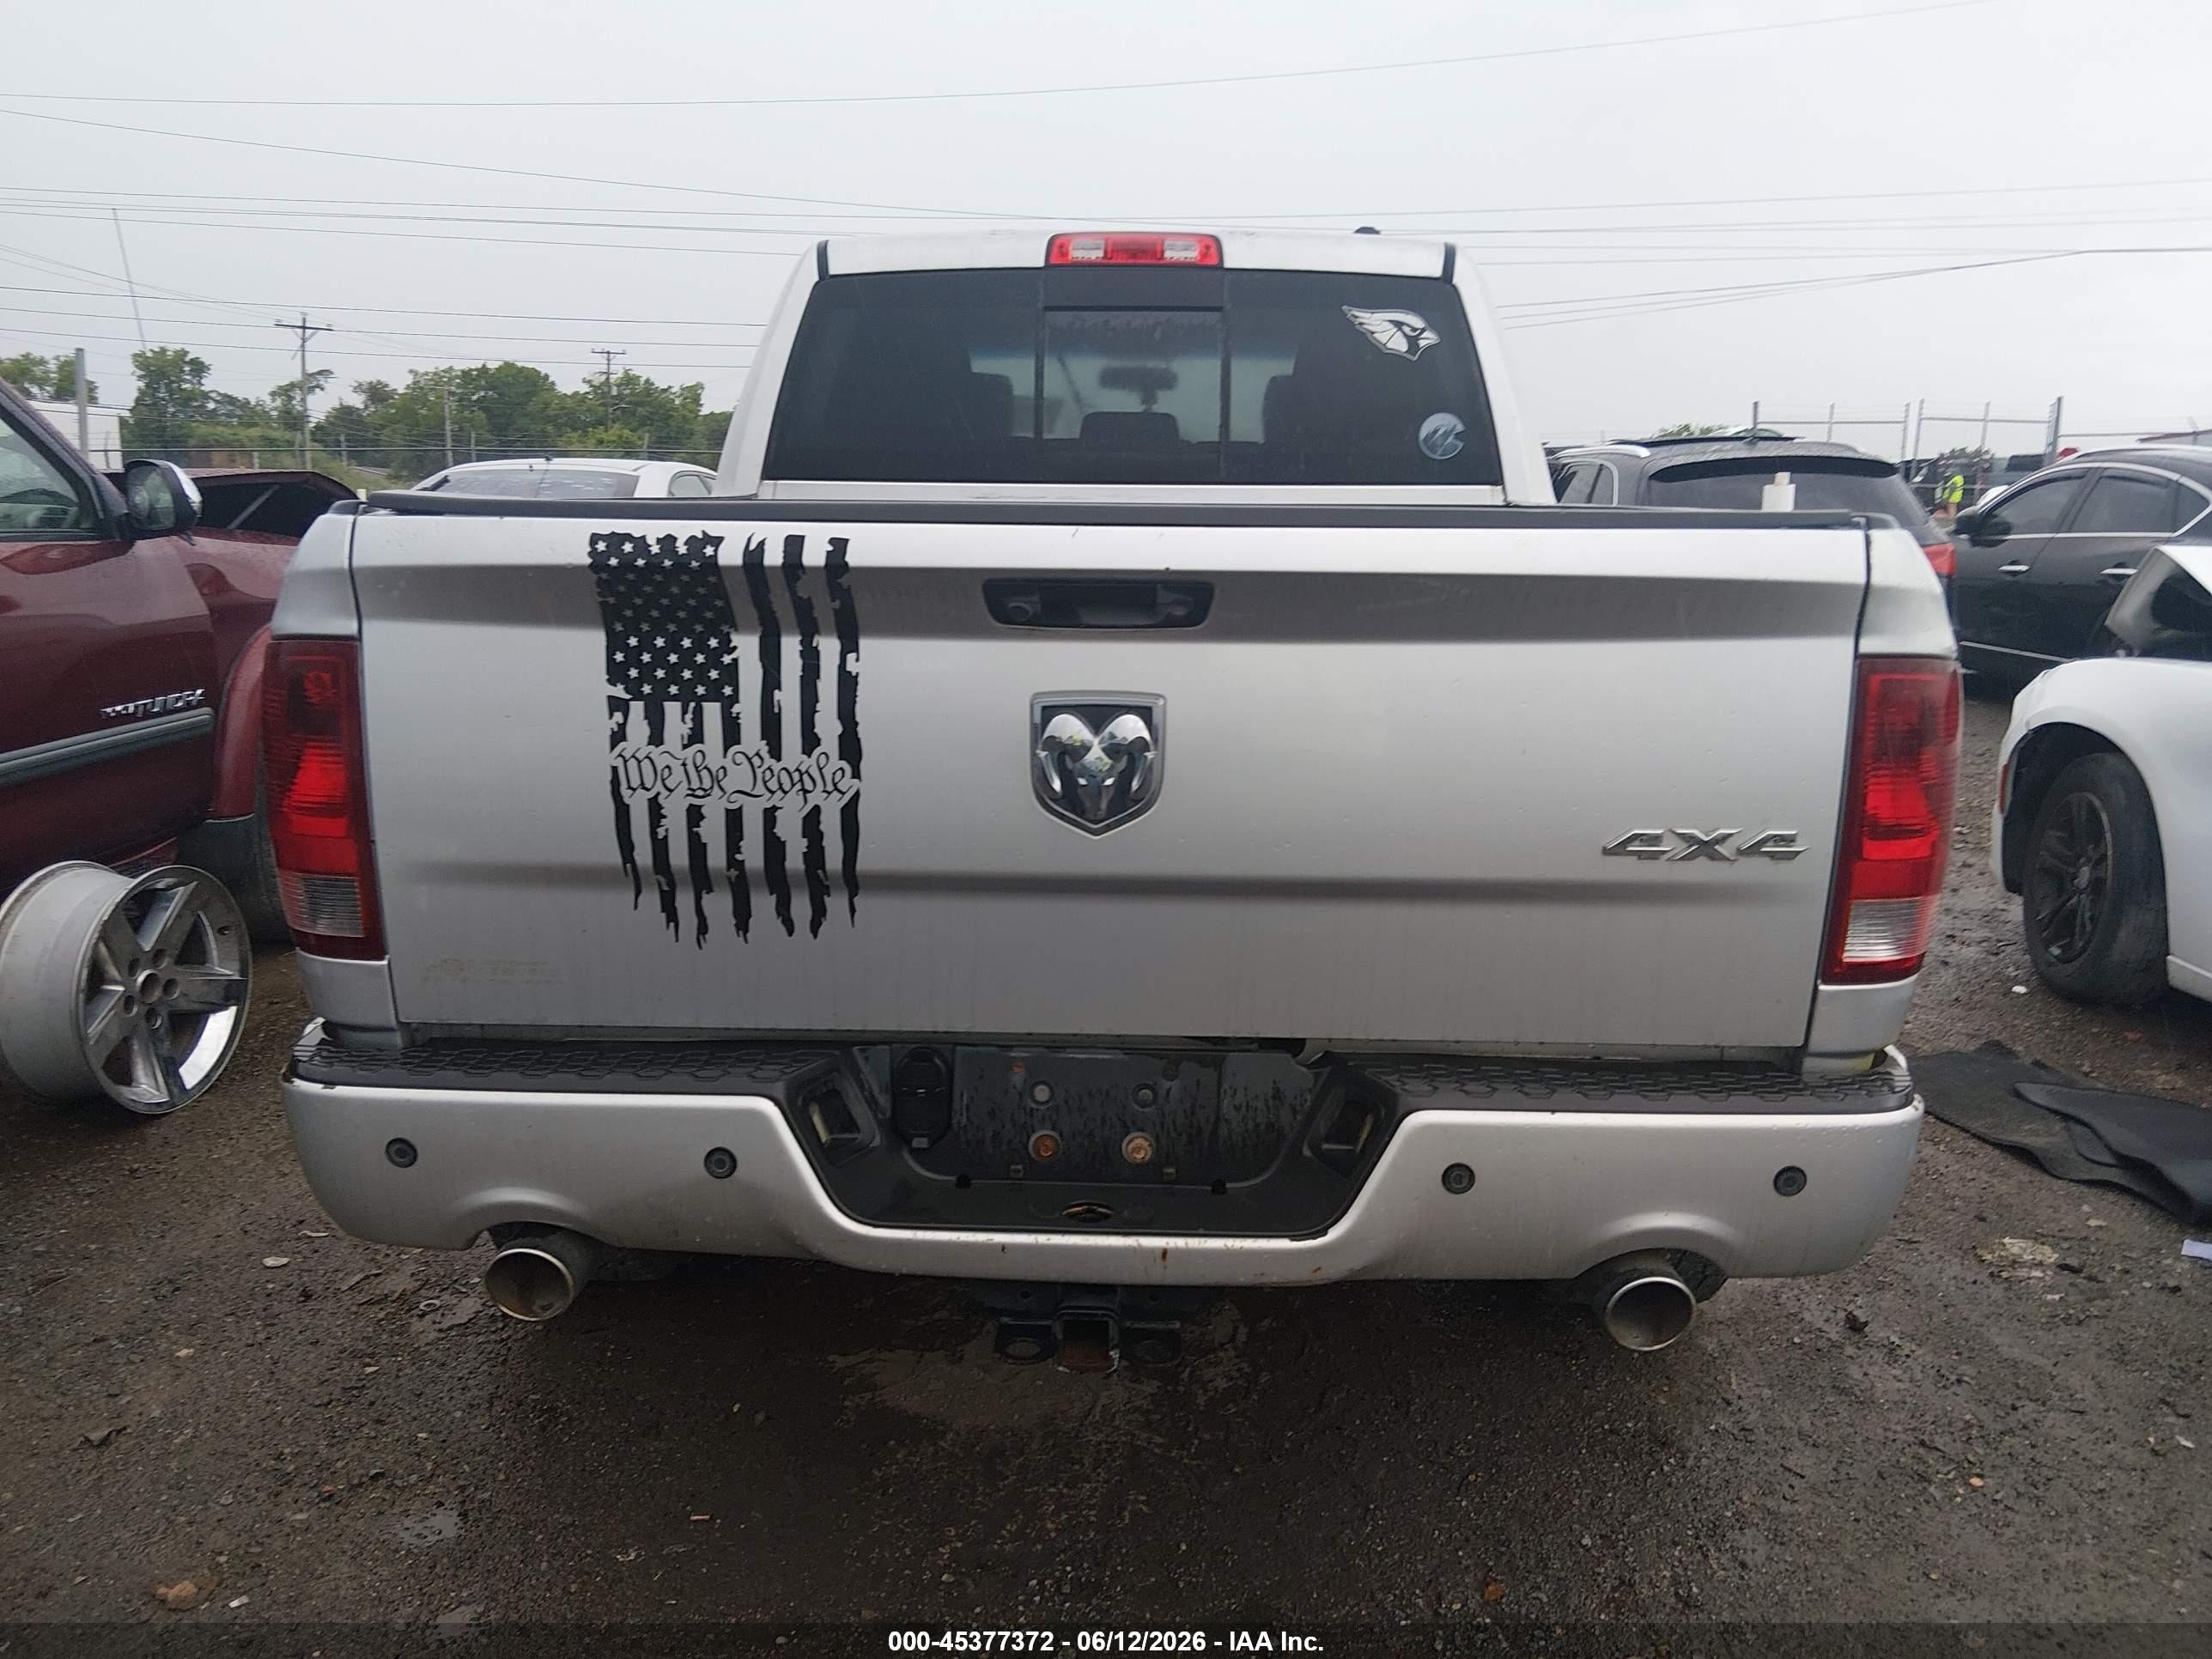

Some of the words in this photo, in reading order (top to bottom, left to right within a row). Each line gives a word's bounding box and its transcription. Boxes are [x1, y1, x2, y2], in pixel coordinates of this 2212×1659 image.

[614, 747, 684, 799] We
[659, 749, 728, 799] the
[727, 748, 854, 812] People
